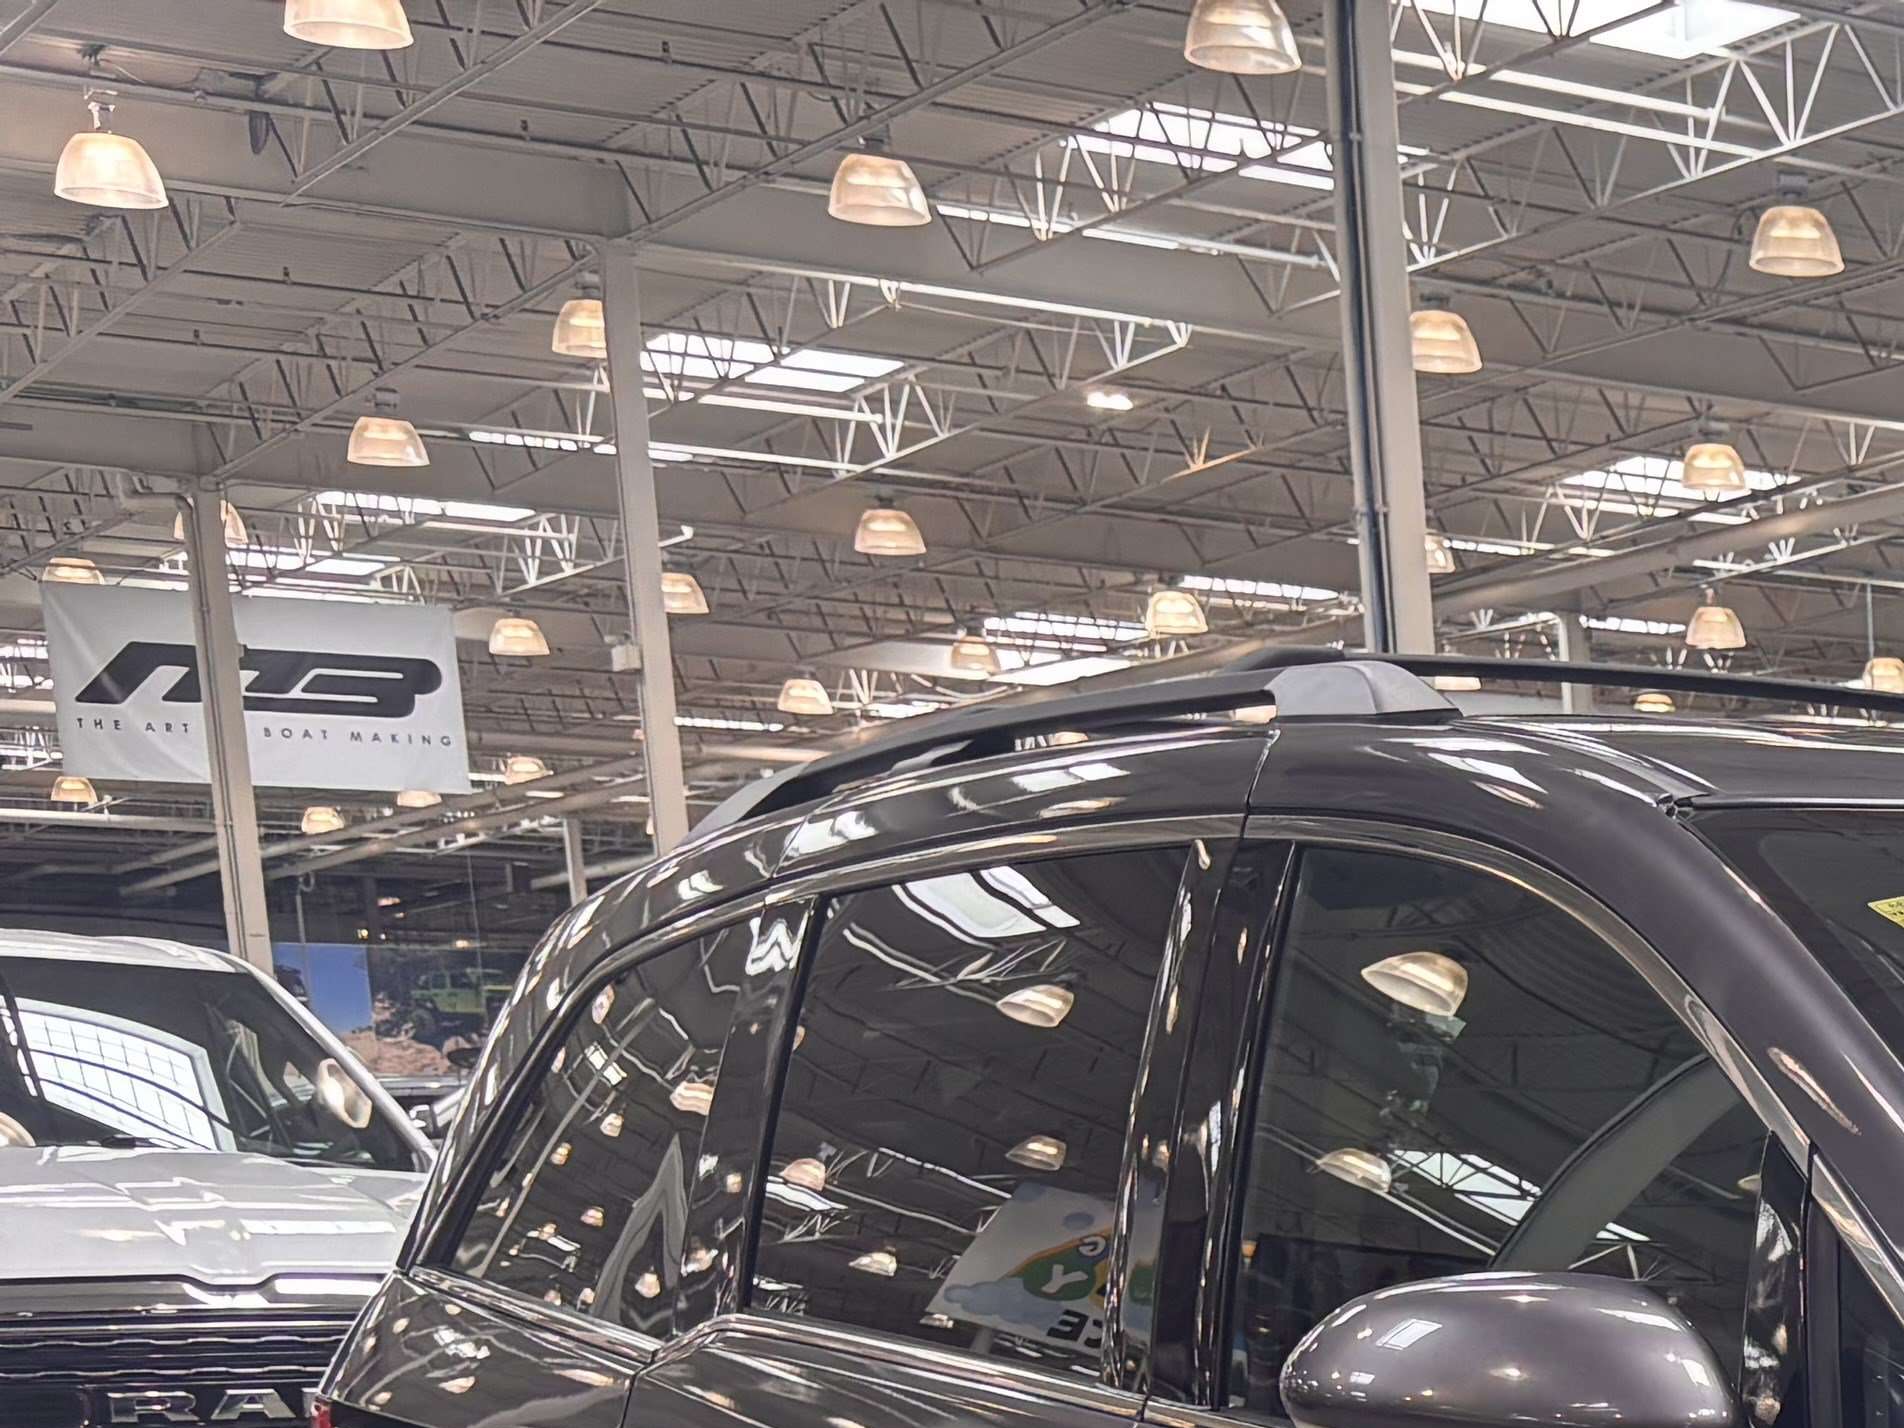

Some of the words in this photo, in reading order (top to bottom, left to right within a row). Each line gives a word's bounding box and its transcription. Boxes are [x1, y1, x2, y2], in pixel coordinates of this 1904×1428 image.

[76, 717, 122, 730] THE
[145, 722, 192, 733] ART
[264, 727, 328, 739] BOAT
[350, 731, 452, 747] MAKING
